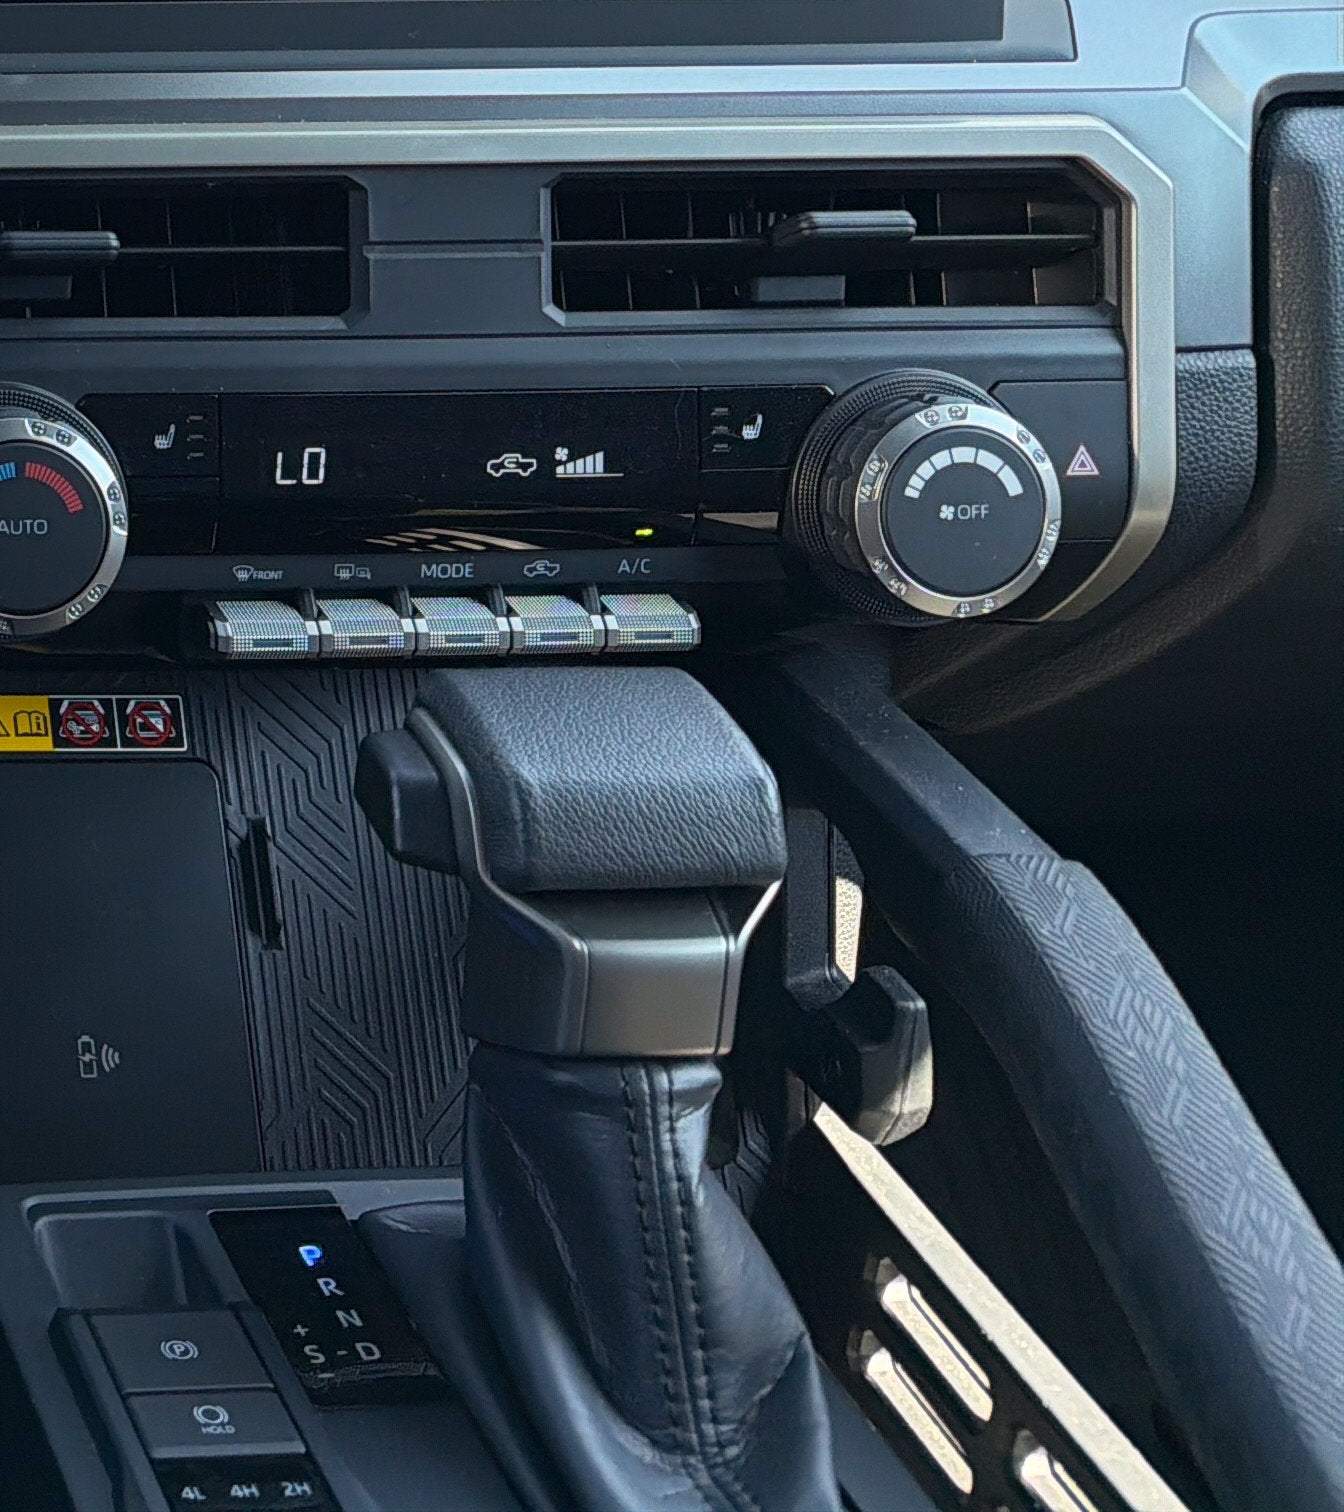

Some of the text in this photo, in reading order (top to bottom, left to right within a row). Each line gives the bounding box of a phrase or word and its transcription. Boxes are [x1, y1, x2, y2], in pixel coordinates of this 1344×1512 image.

[275, 446, 327, 485] LO
[956, 502, 991, 523] OFF
[252, 570, 284, 581] FRONT
[420, 563, 475, 579] MODE
[617, 557, 652, 577] A/C
[298, 1244, 323, 1267] P
[316, 1277, 345, 1297] R
[335, 1308, 364, 1328] N
[303, 1341, 382, 1364] S D
[200, 1424, 237, 1435] HOLD
[181, 1480, 313, 1500] 4L 4H 2H
